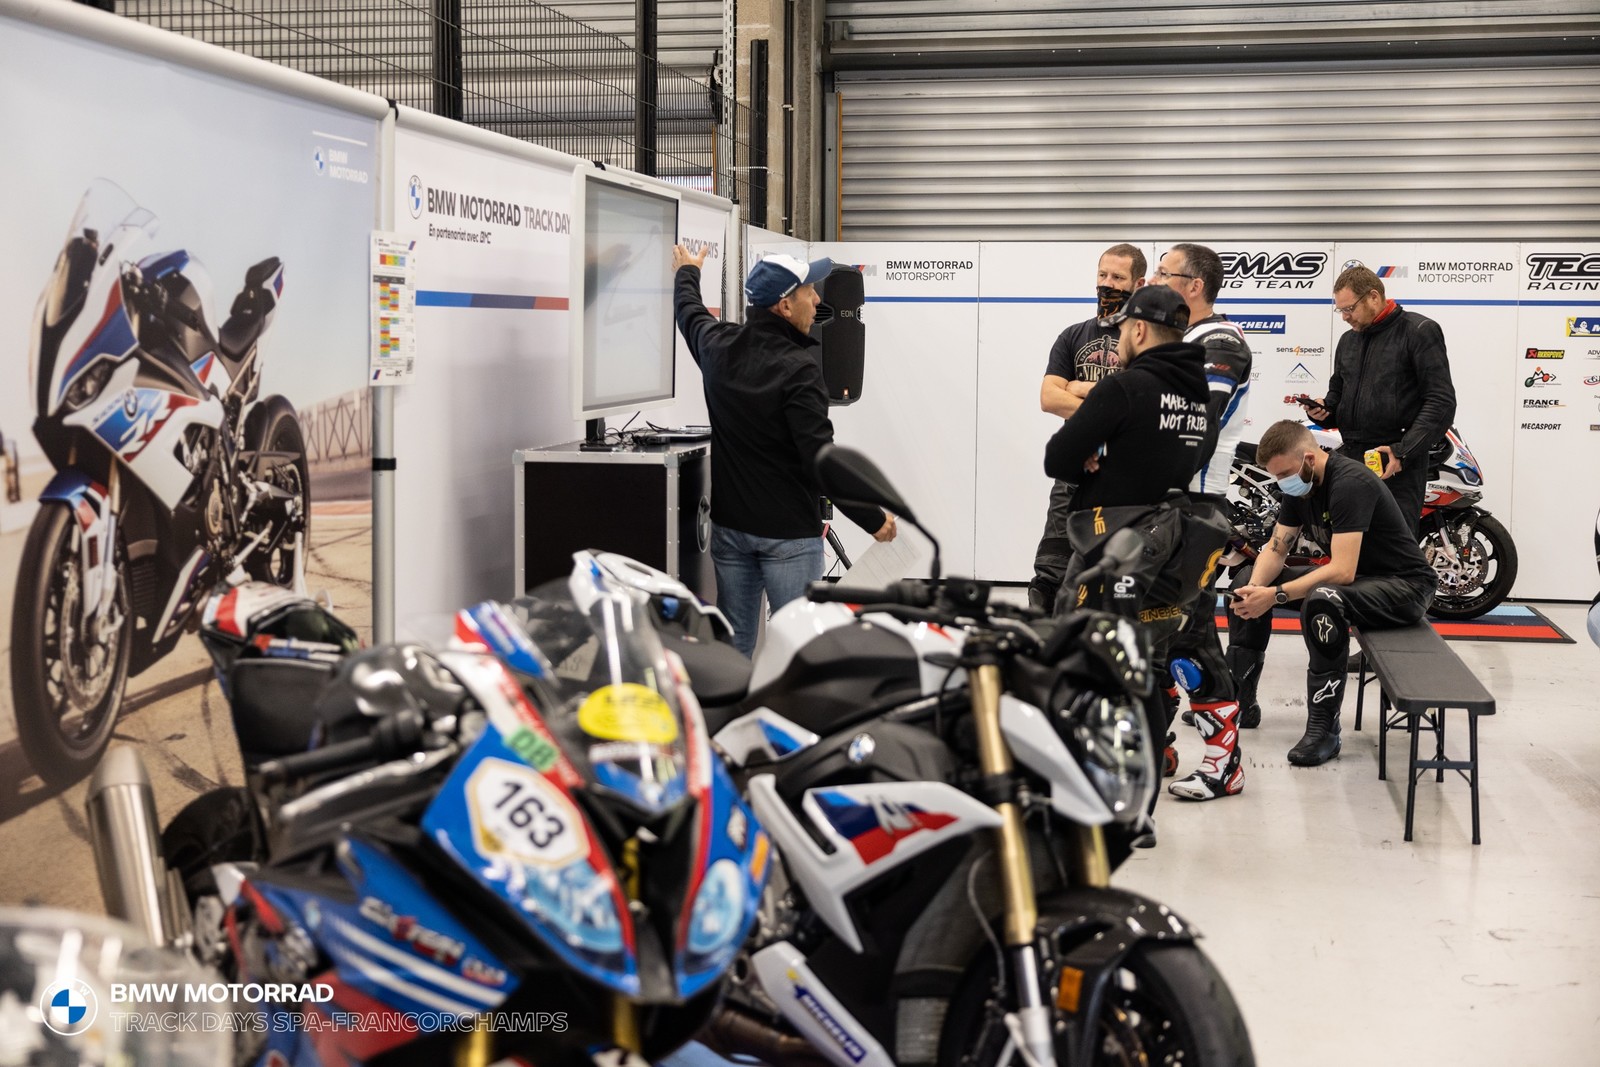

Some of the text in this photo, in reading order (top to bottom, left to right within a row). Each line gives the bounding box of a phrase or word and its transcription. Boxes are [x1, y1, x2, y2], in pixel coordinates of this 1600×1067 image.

[329, 148, 348, 164] BMW
[329, 164, 368, 184] MOTORRAD
[427, 187, 457, 217] BMW
[460, 193, 522, 227] MOTORRAD
[523, 205, 555, 233] TRACK
[428, 223, 436, 237] En
[436, 227, 467, 242] partenariat
[467, 231, 479, 243] avec
[703, 240, 719, 259] AYS
[885, 260, 912, 270] BMW
[913, 260, 974, 270] MOTORRAD
[1418, 262, 1446, 271] BMW
[1448, 262, 1514, 272] MOTORRAD
[885, 271, 956, 281] MOTORSPORT
[1417, 273, 1495, 283] MOTORSPORT
[1255, 280, 1314, 289] TEAM
[840, 309, 854, 318] EON
[1236, 321, 1285, 329] CHELIN
[1160, 393, 1189, 411] MAKE
[1159, 413, 1185, 431] NOT
[1521, 423, 1562, 431] MECASPORT
[491, 780, 564, 849] 163
